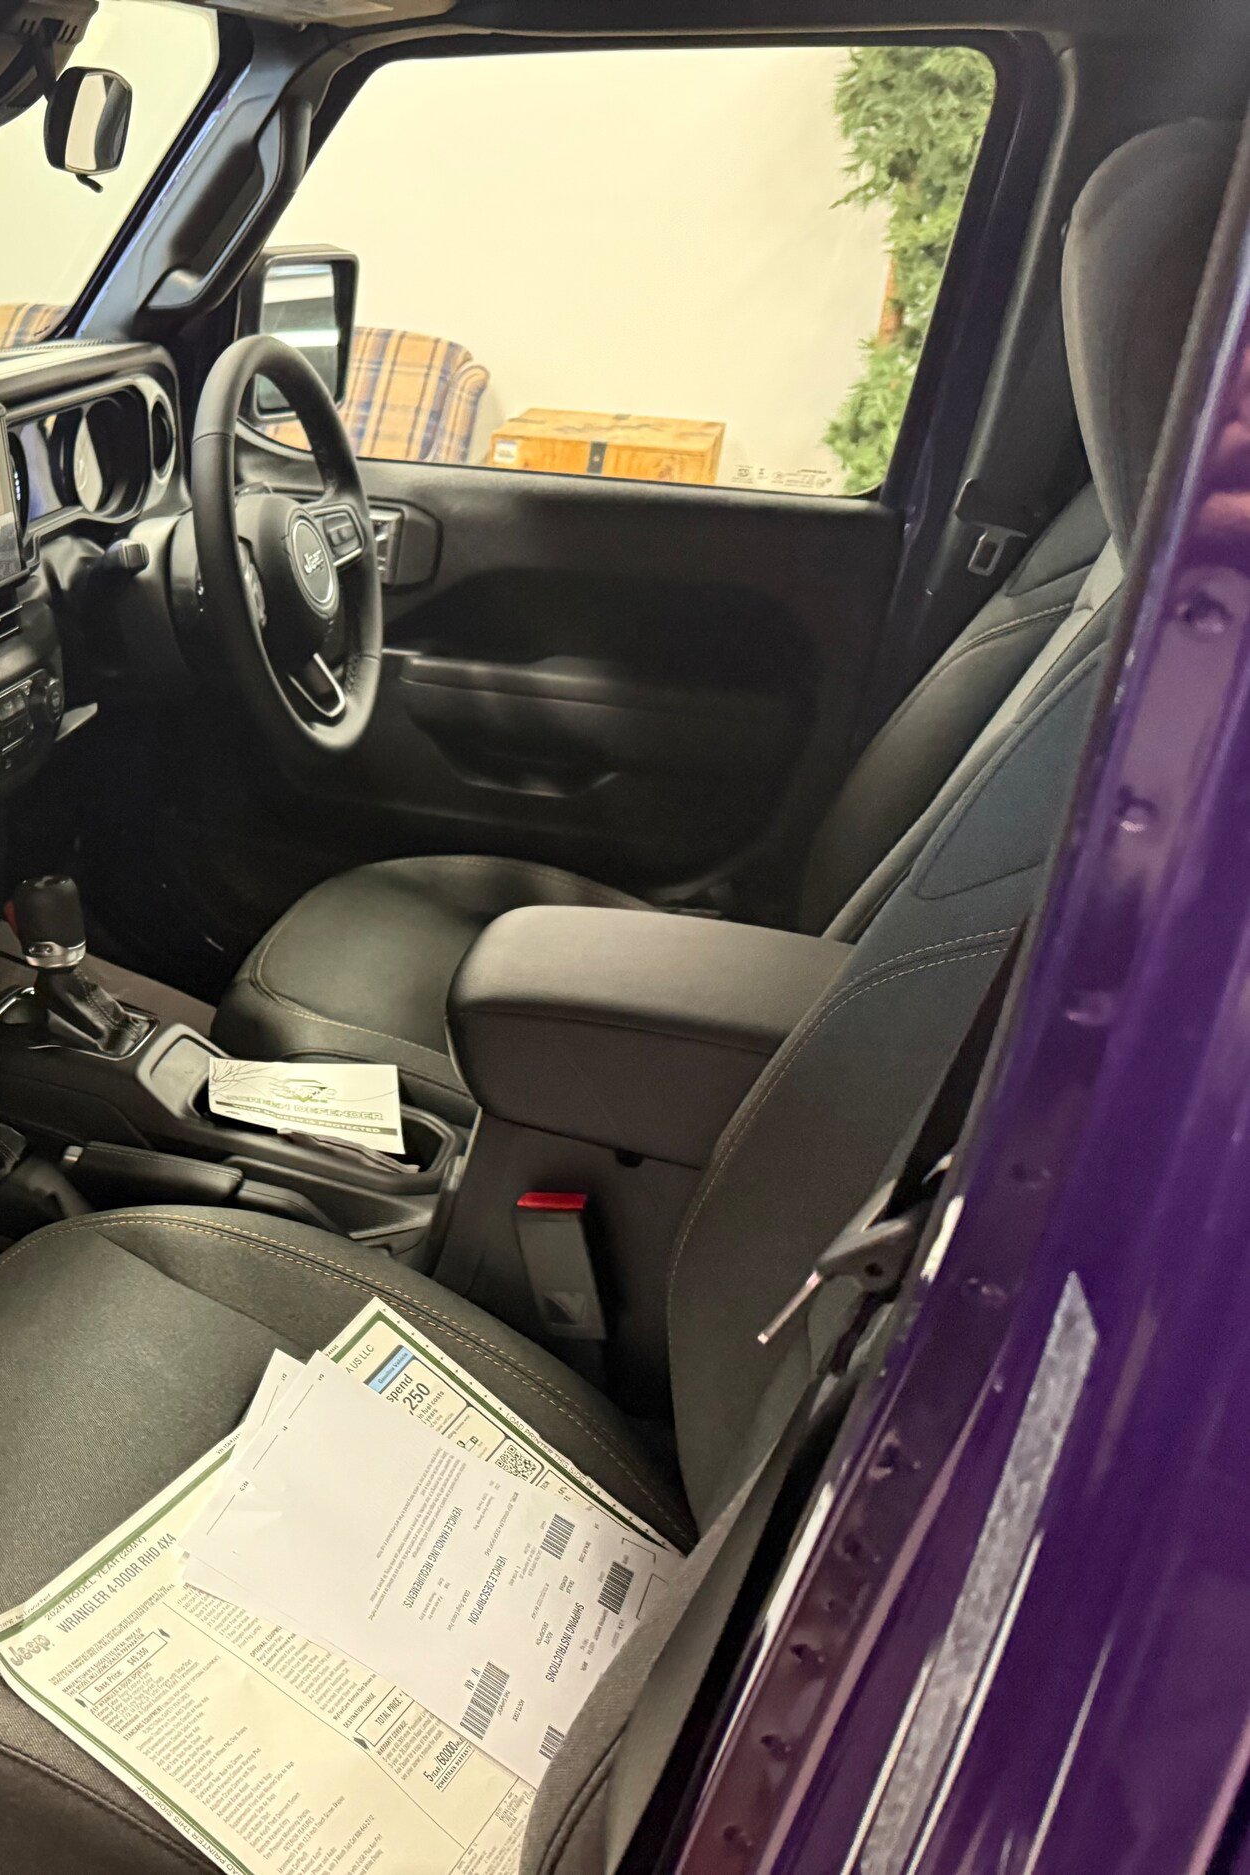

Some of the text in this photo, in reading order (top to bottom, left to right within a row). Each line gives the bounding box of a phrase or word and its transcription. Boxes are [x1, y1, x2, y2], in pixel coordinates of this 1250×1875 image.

[294, 1102, 384, 1121] DEFENDER
[350, 1343, 374, 1368] US LLC
[391, 1351, 409, 1368] Vehicle
[385, 1372, 414, 1404] spend
[421, 1402, 433, 1415] fuel
[429, 1389, 444, 1405] costs
[424, 1407, 438, 1422] years
[504, 1412, 525, 1431] LOAD
[523, 1428, 554, 1455] PRINTER
[551, 1452, 569, 1468] THIS
[567, 1466, 584, 1481] SIDE
[583, 1480, 594, 1489] IN
[442, 1505, 463, 1531] VEHICLE
[426, 1528, 451, 1562] HANDLING
[55, 1588, 111, 1635] WRANGLER
[103, 1561, 143, 1594] 4-DOOR
[136, 1545, 161, 1566] RHD
[155, 1531, 177, 1551] 4X4
[62, 1576, 97, 1605] MODEL
[94, 1556, 121, 1579] YEAR
[401, 1559, 434, 1609] REQUIREMENTS:
[466, 1554, 507, 1625] VEHICLE DESCRIPTION
[9, 1633, 52, 1667] Jeep
[249, 1639, 268, 1657] OPTIONAL
[544, 1601, 585, 1683] SHIPPING INSTRUCTIONS
[93, 1679, 110, 1693] Base
[106, 1667, 124, 1683] Price:
[374, 1695, 403, 1725] TOTAL PRICE:
[375, 1719, 408, 1755] WARRANTY COVERAGE
[434, 1744, 474, 1790] POWERTRAIN WARRANTY
[137, 1785, 155, 1800] OUT
[154, 1800, 172, 1817] SIDE
[173, 1816, 192, 1834] THIS
[191, 1833, 228, 1865] PRINTER
